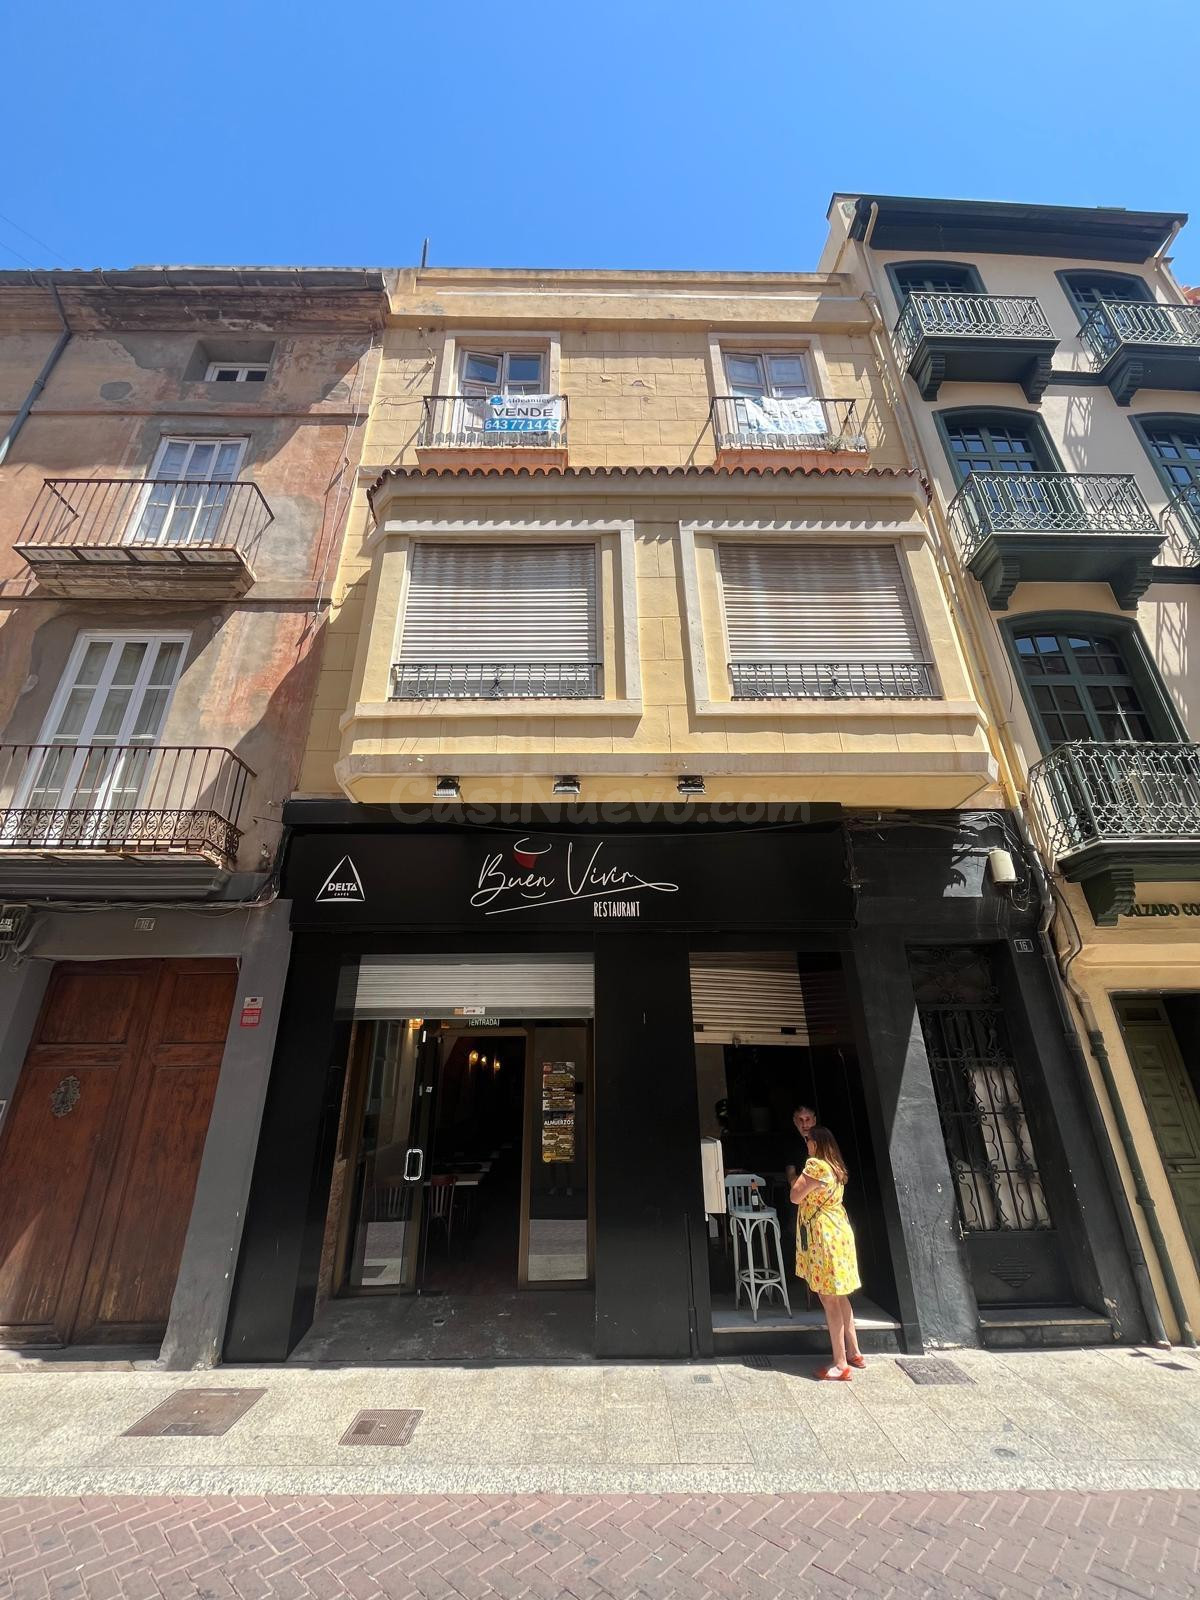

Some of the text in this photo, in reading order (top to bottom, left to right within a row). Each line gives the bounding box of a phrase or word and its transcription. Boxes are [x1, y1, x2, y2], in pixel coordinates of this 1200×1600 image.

[494, 407, 554, 417] VENDE
[327, 882, 358, 892] DELTA
[470, 853, 555, 907] Buen
[593, 901, 641, 917] RESTAURANT
[1122, 903, 1180, 917] ALZADO
